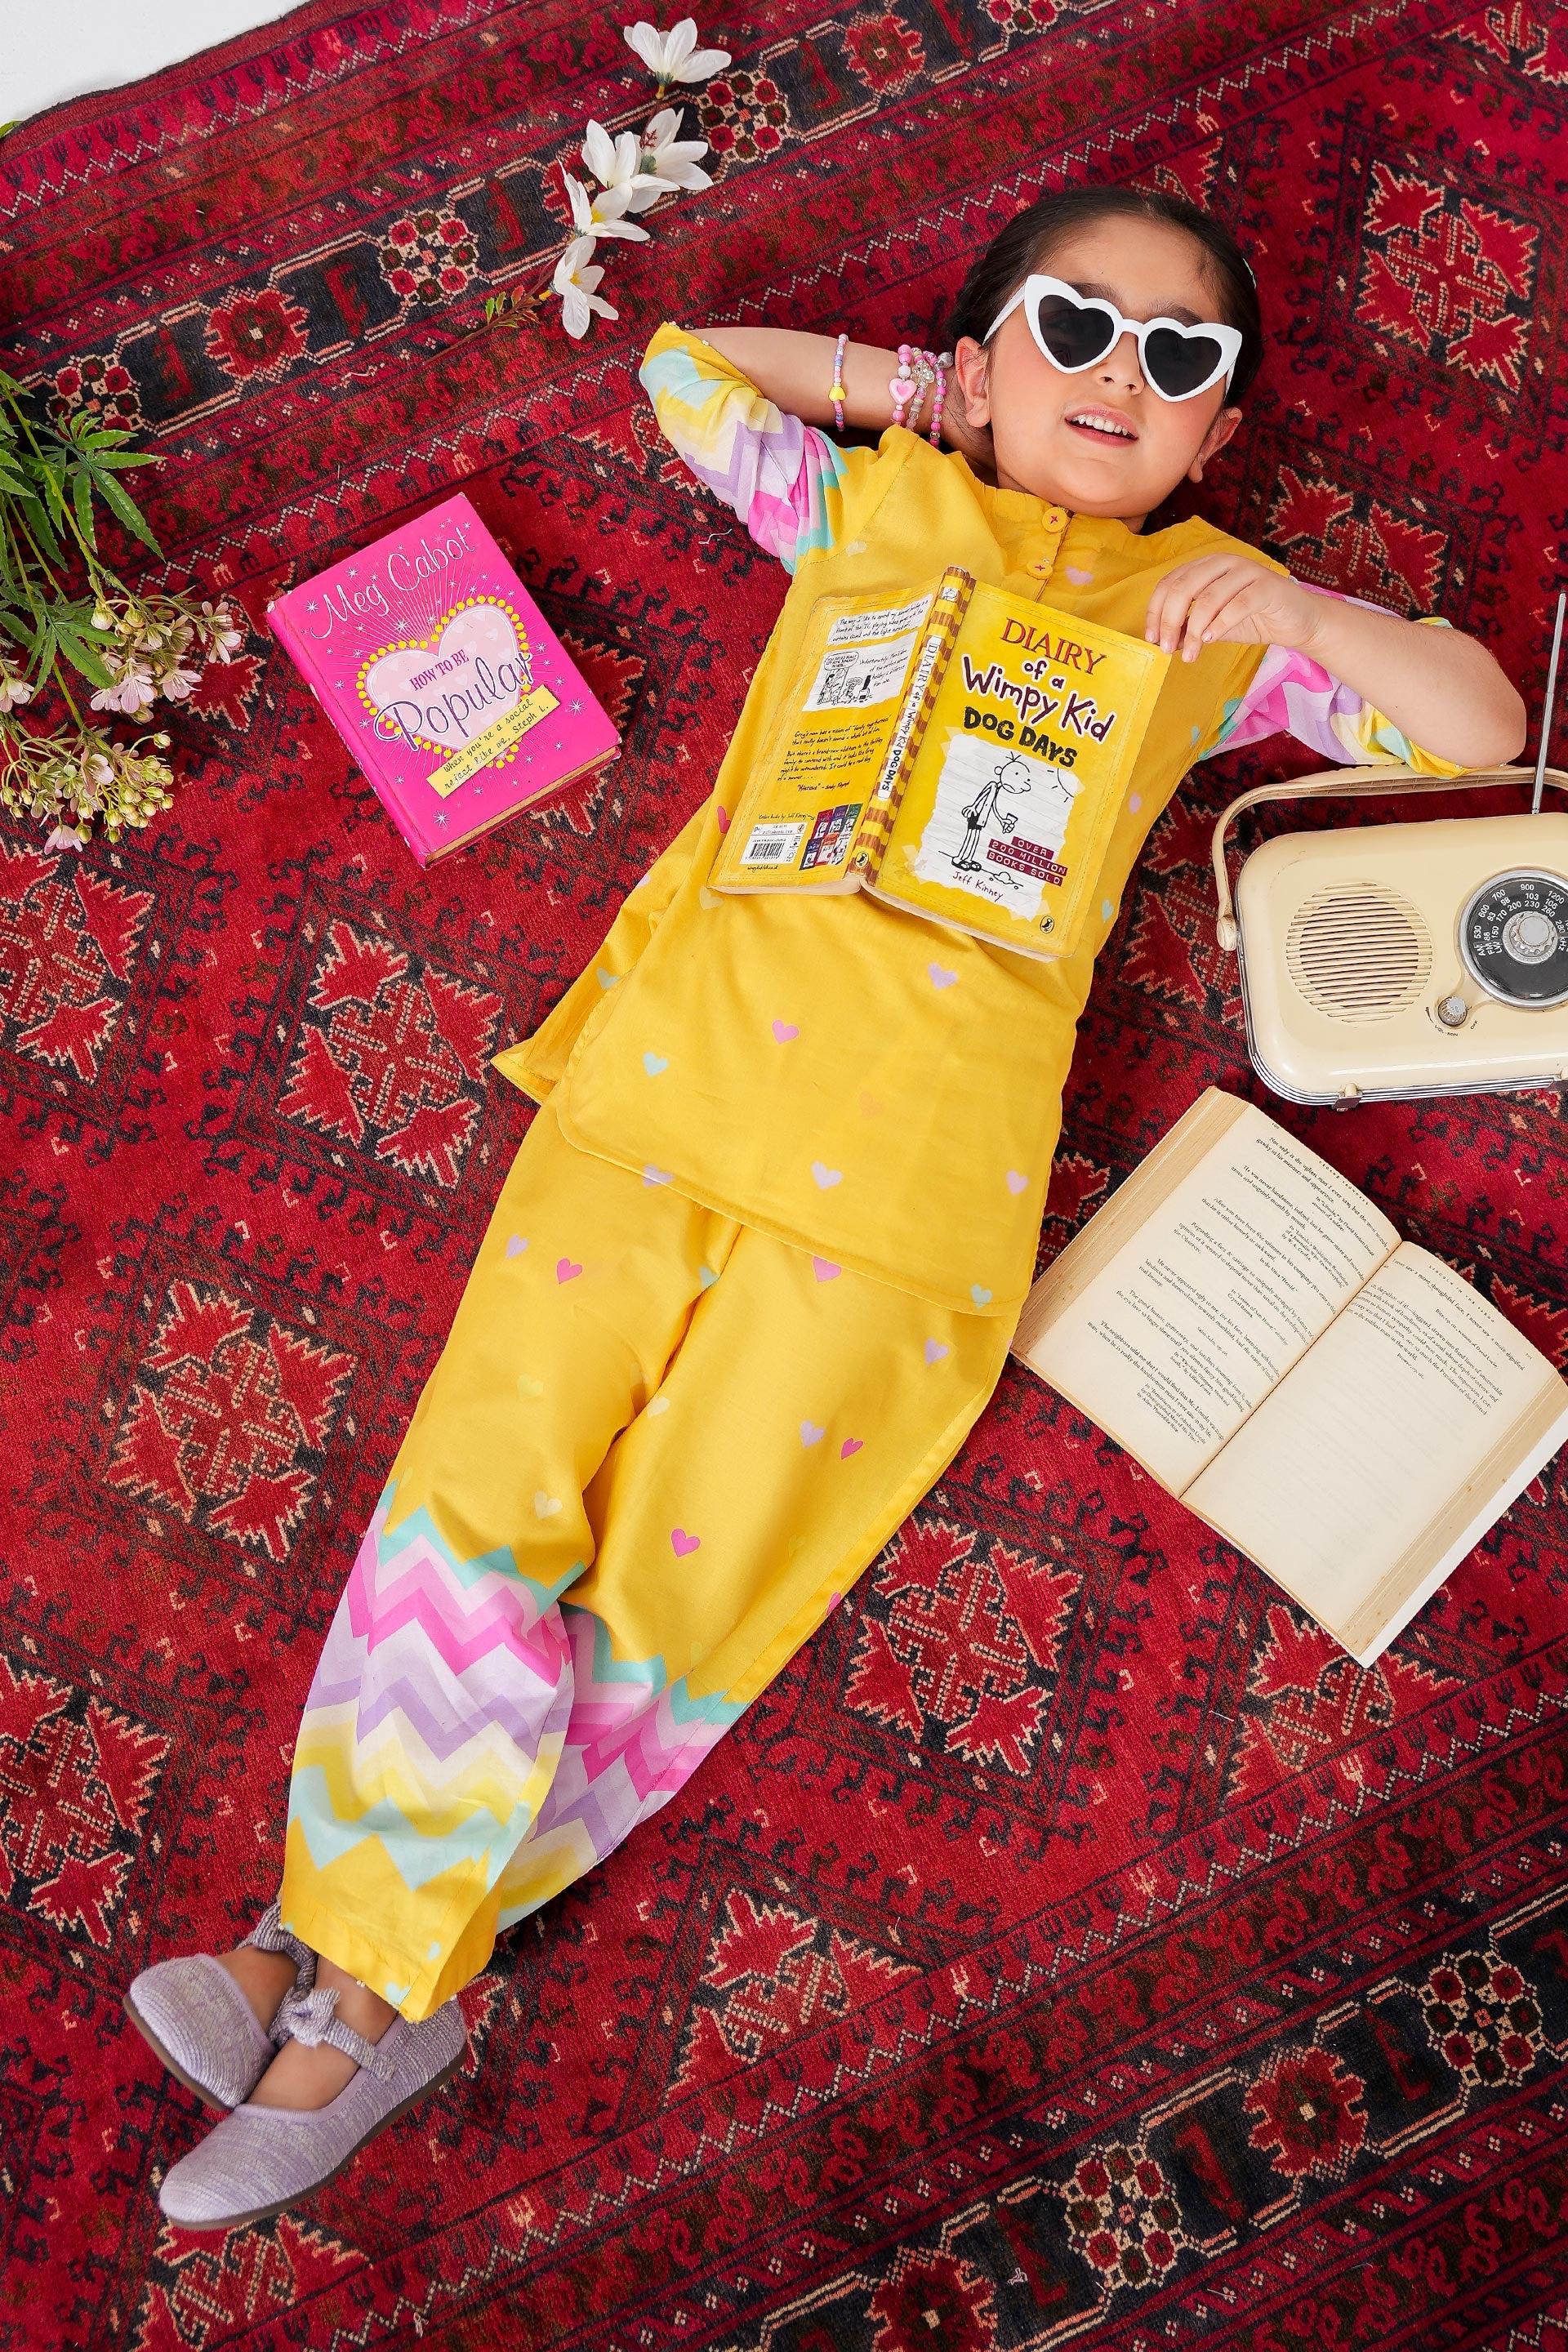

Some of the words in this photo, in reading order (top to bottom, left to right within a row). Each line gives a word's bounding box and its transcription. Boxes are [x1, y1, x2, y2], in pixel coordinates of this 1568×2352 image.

[310, 585, 390, 639] Meg
[386, 527, 474, 591] Cabot
[409, 673, 437, 691] HOW
[435, 660, 453, 676] TO
[452, 649, 470, 667] BE
[1024, 660, 1047, 679] of
[1051, 678, 1065, 689] a
[374, 653, 533, 751] Popular
[913, 692, 921, 701] of
[964, 657, 1058, 724] Wimpy
[1062, 693, 1115, 742] Kid
[443, 755, 465, 773] When
[466, 731, 495, 757] you're
[496, 724, 503, 732] a
[505, 698, 533, 724] social
[474, 747, 494, 765] like
[496, 737, 510, 749] me,
[512, 712, 537, 734] Steph
[538, 705, 549, 713] L.
[901, 711, 916, 735] Wimpy
[963, 706, 1014, 741] DOG
[1019, 726, 1078, 768] DAYS
[896, 735, 907, 748] Kid
[890, 750, 902, 768] DOG
[881, 769, 897, 791] DAYS
[992, 841, 1014, 855] 200
[1020, 853, 1067, 875] MILLION
[1018, 840, 1047, 857] OVER
[988, 853, 1025, 871] BOOKS
[1031, 869, 1060, 884] SOLD
[952, 871, 973, 884] Jeff
[975, 879, 1004, 902] Kinney
[1478, 905, 1490, 917] 600
[1492, 889, 1505, 901] 700
[1548, 891, 1565, 904] 1200
[1484, 932, 1490, 941] 88
[1487, 912, 1495, 921] 93
[1500, 897, 1510, 906] 98
[1526, 893, 1539, 901] 103
[1545, 898, 1558, 909] 106
[1491, 926, 1499, 938] 150
[1496, 910, 1508, 922] 170
[1508, 902, 1521, 911] 200
[1541, 905, 1555, 917] 260
[1555, 920, 1565, 933] 280
[1279, 1145, 1290, 1156] only
[1258, 1178, 1272, 1190] never
[1301, 1174, 1312, 1183] and
[1468, 1316, 1483, 1329] never
